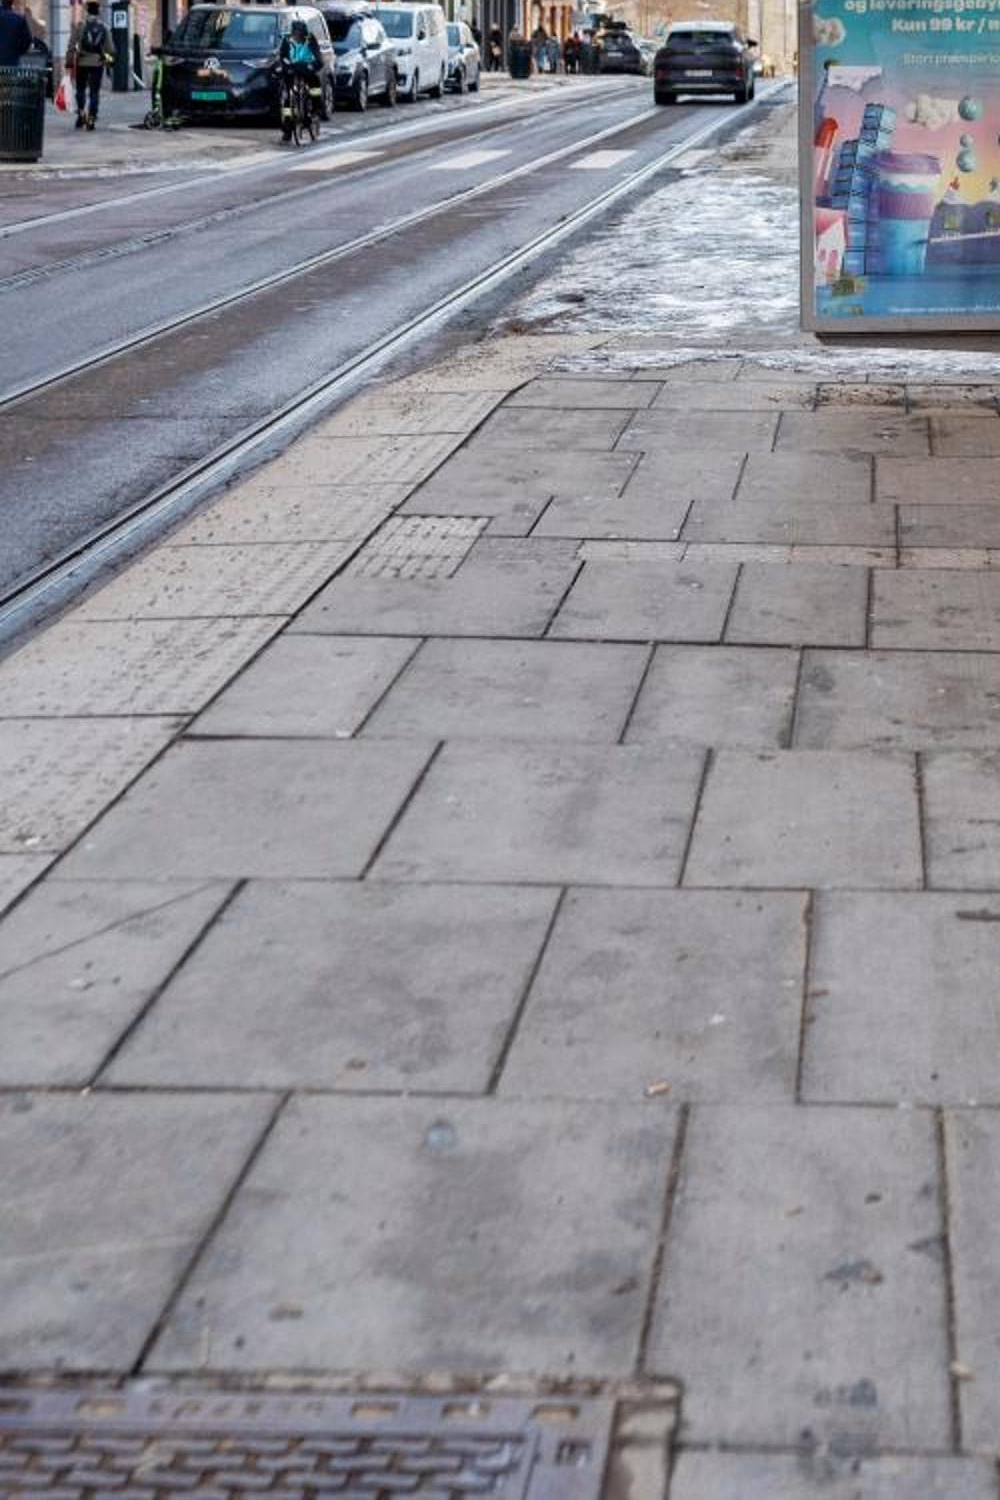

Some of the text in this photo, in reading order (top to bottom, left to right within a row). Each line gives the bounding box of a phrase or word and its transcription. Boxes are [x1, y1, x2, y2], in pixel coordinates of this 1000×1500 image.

[844, 0, 867, 13] og
[892, 18, 927, 32] Kun
[955, 17, 975, 32] kr
